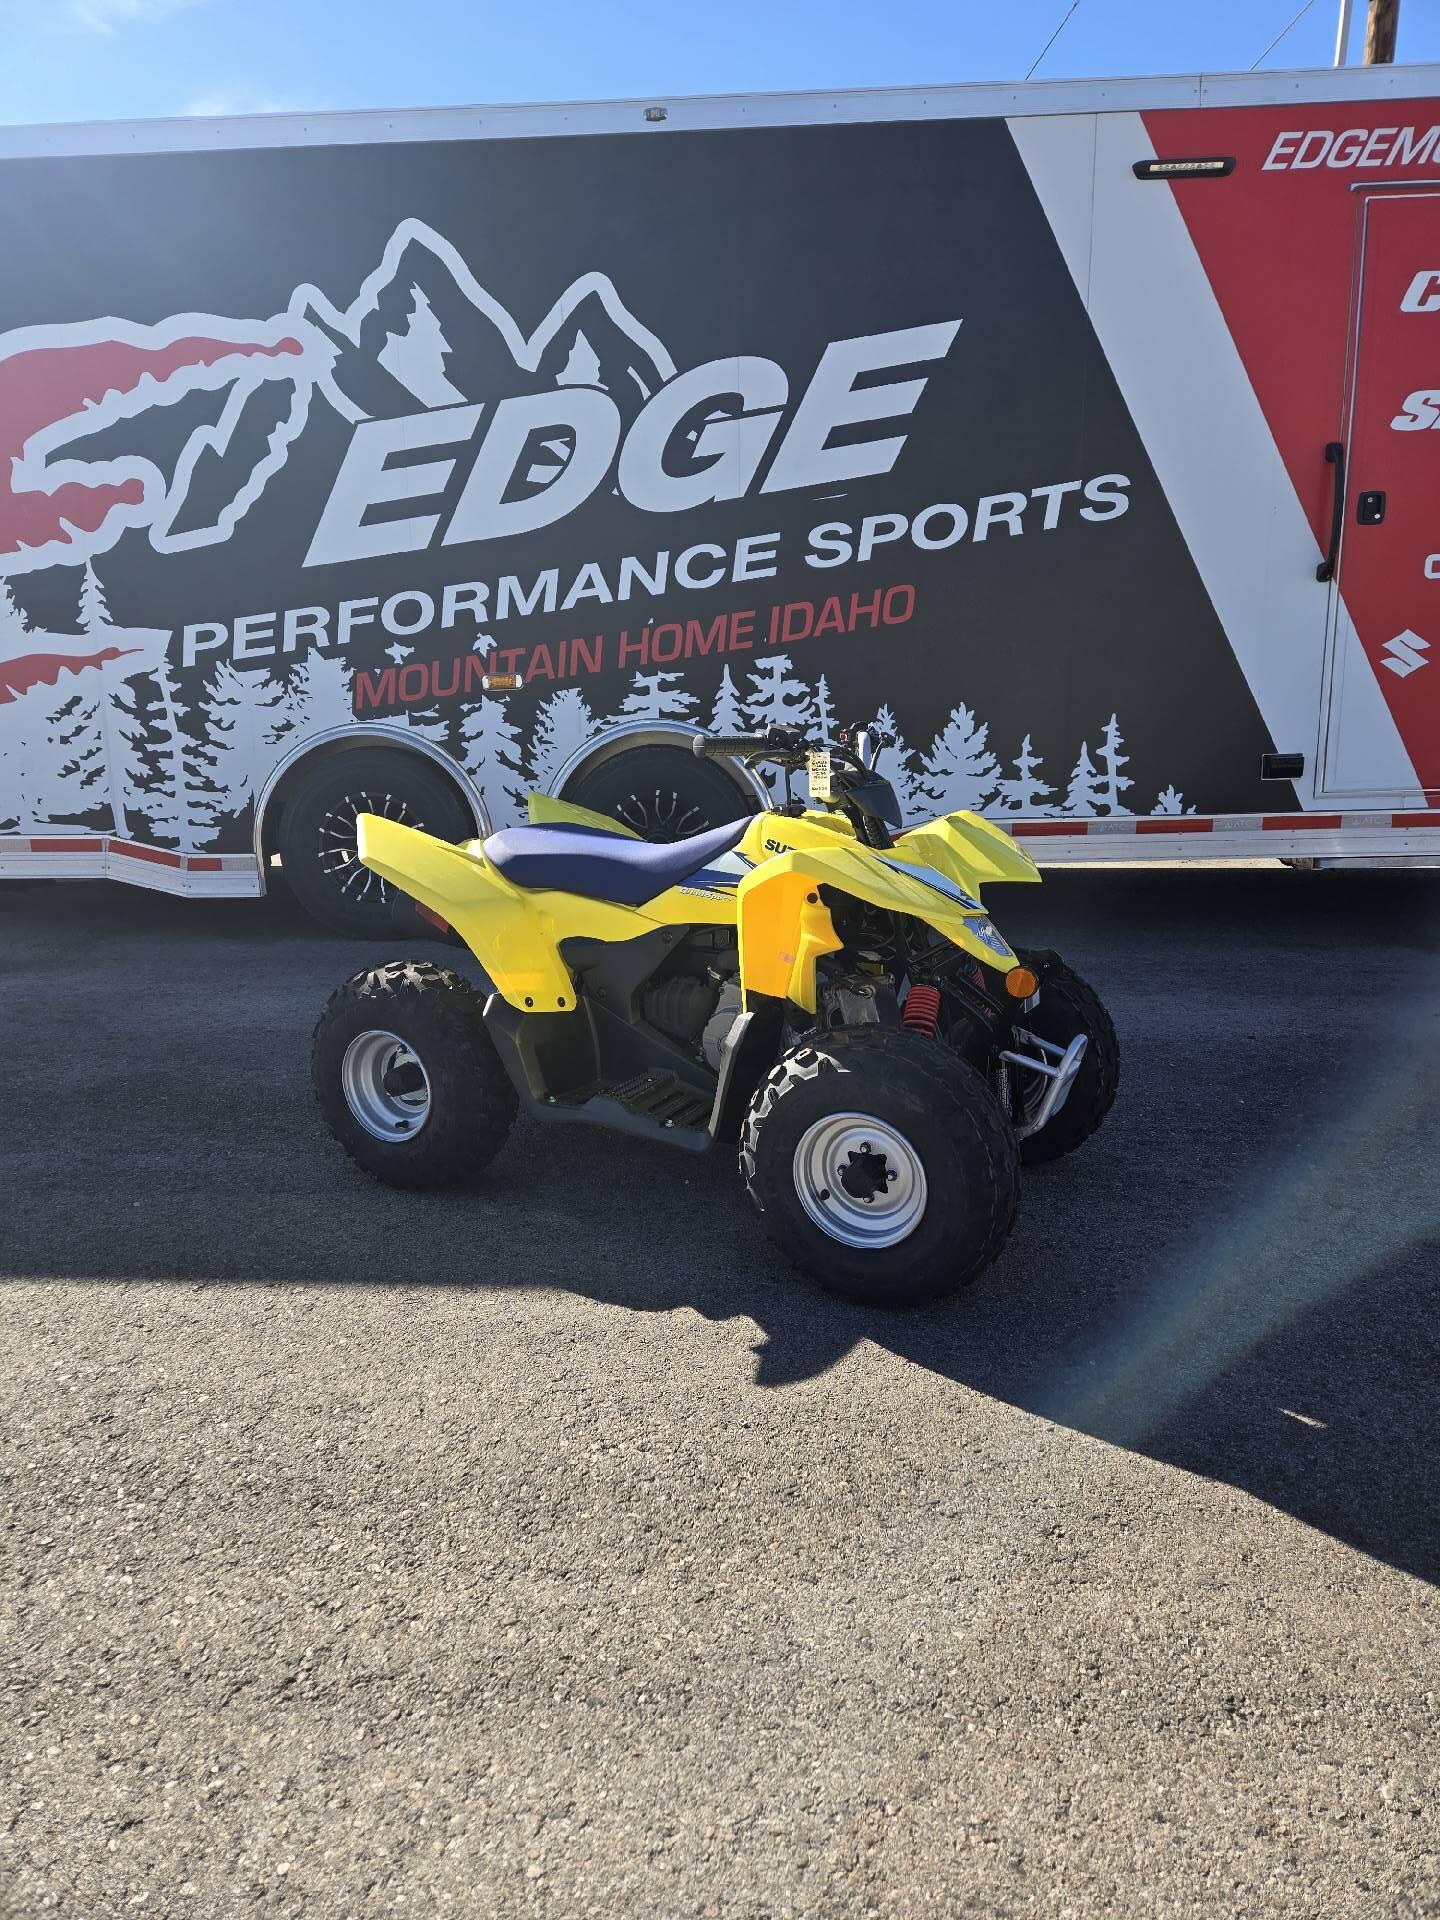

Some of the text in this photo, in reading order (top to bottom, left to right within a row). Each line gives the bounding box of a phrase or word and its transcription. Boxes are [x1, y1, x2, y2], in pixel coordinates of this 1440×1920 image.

[1261, 125, 1440, 170] EDGEM
[302, 319, 963, 567] EDGE
[182, 473, 1131, 667] PERFORMANCE SPORTS
[355, 584, 916, 710] MOUNTAIN HOME IDAHO
[764, 839, 797, 854] SU
